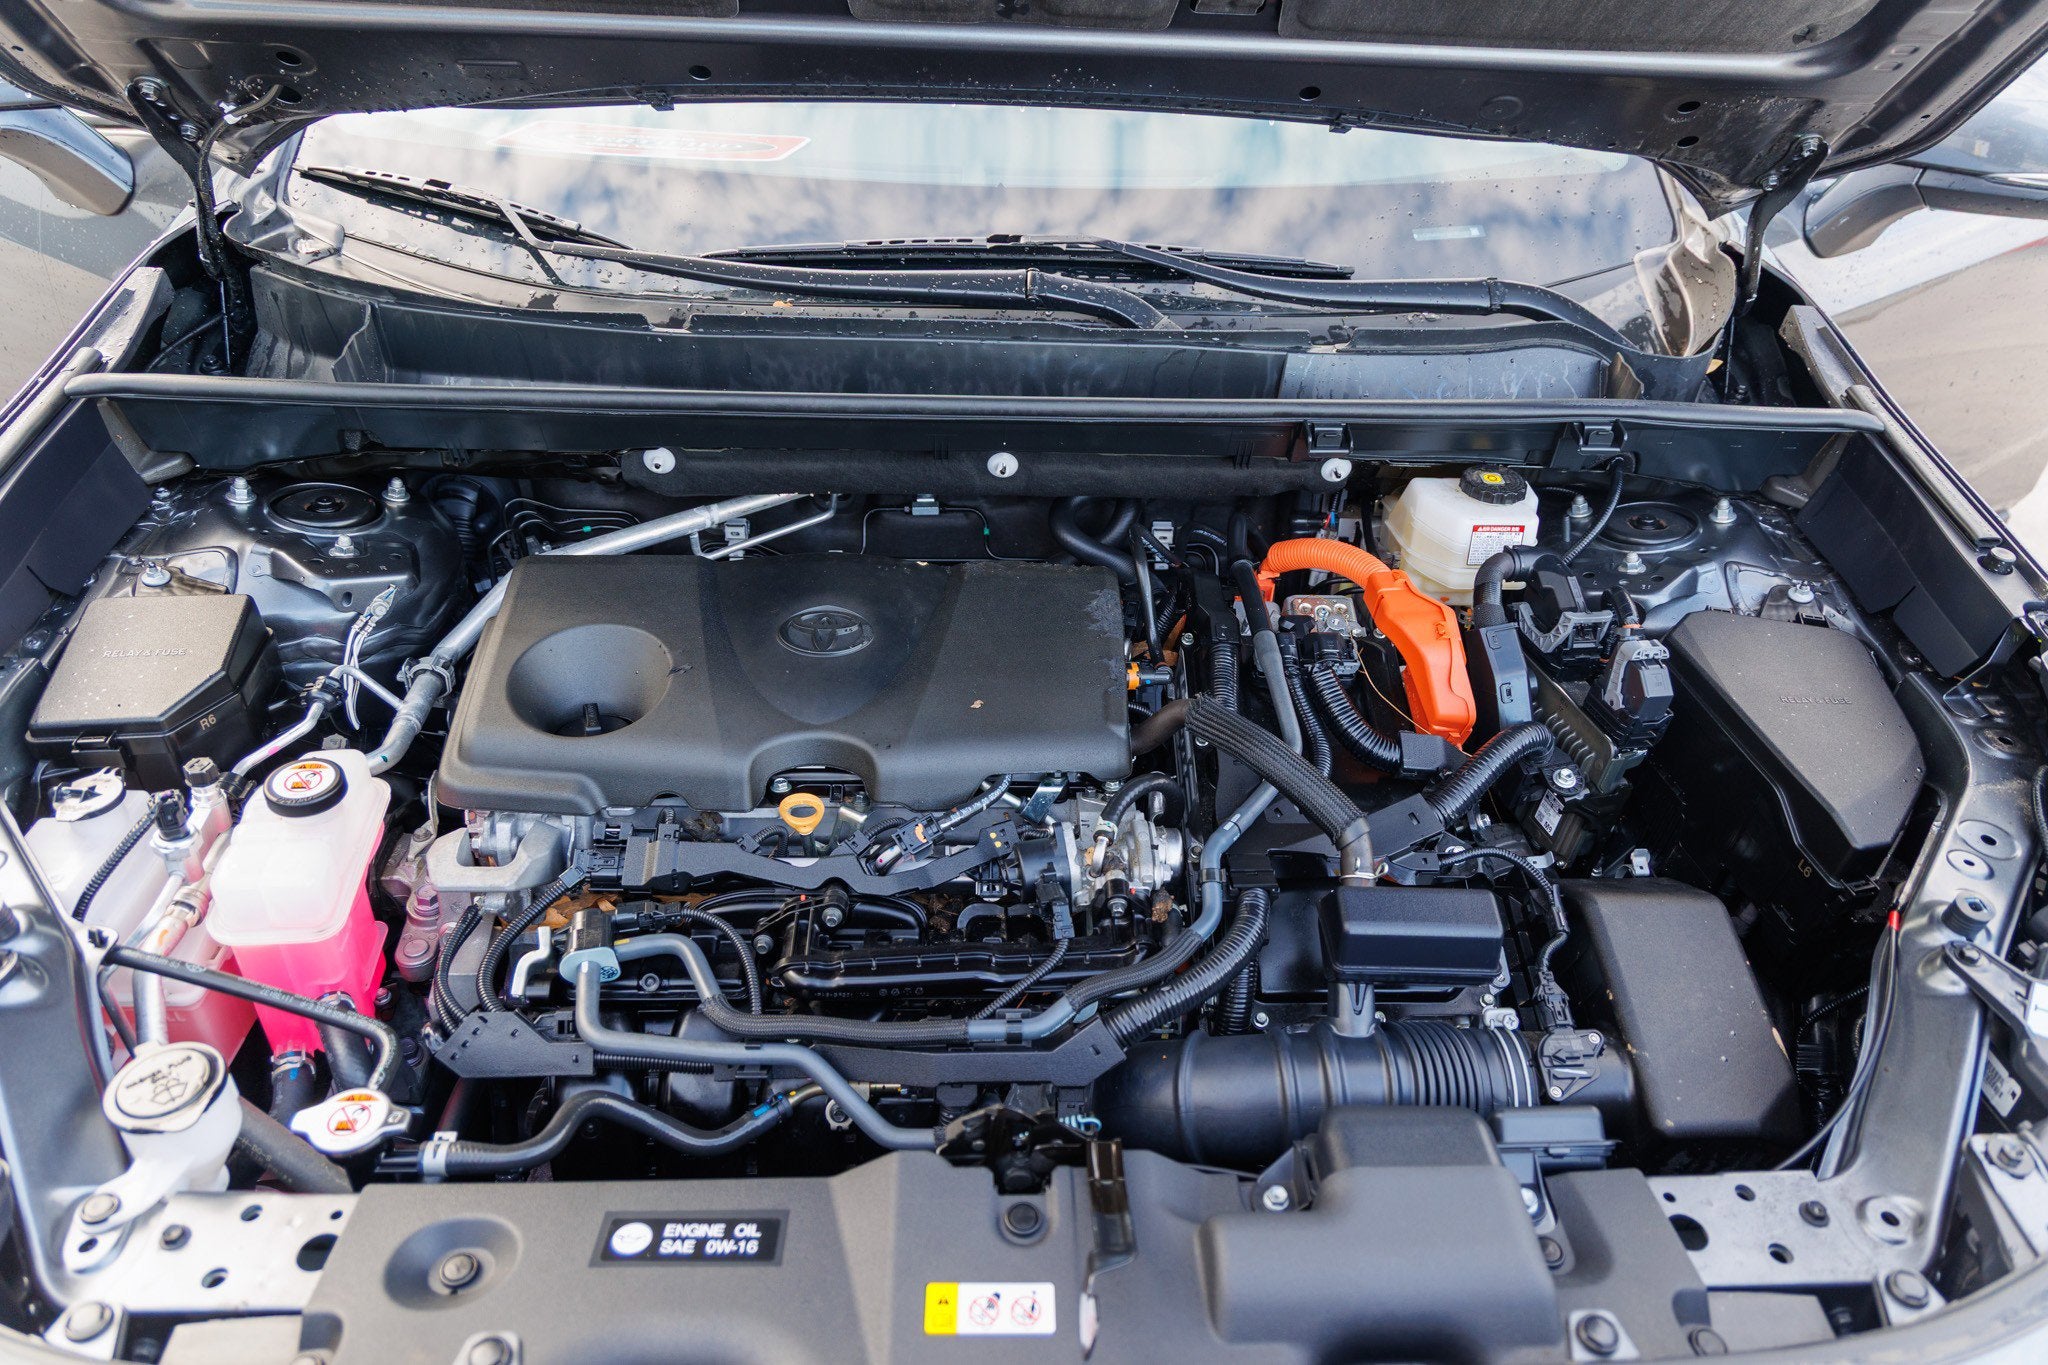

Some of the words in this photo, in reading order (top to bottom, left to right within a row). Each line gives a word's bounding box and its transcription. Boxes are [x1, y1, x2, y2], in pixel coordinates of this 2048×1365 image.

[102, 649, 142, 658] RELAY
[155, 648, 188, 656] FUSE
[1780, 696, 1812, 704] RELAY
[200, 714, 217, 731] R6
[1798, 859, 1812, 878] L6
[662, 1222, 727, 1239] ENGINE
[733, 1222, 762, 1239] OIL
[658, 1239, 697, 1255] SAE
